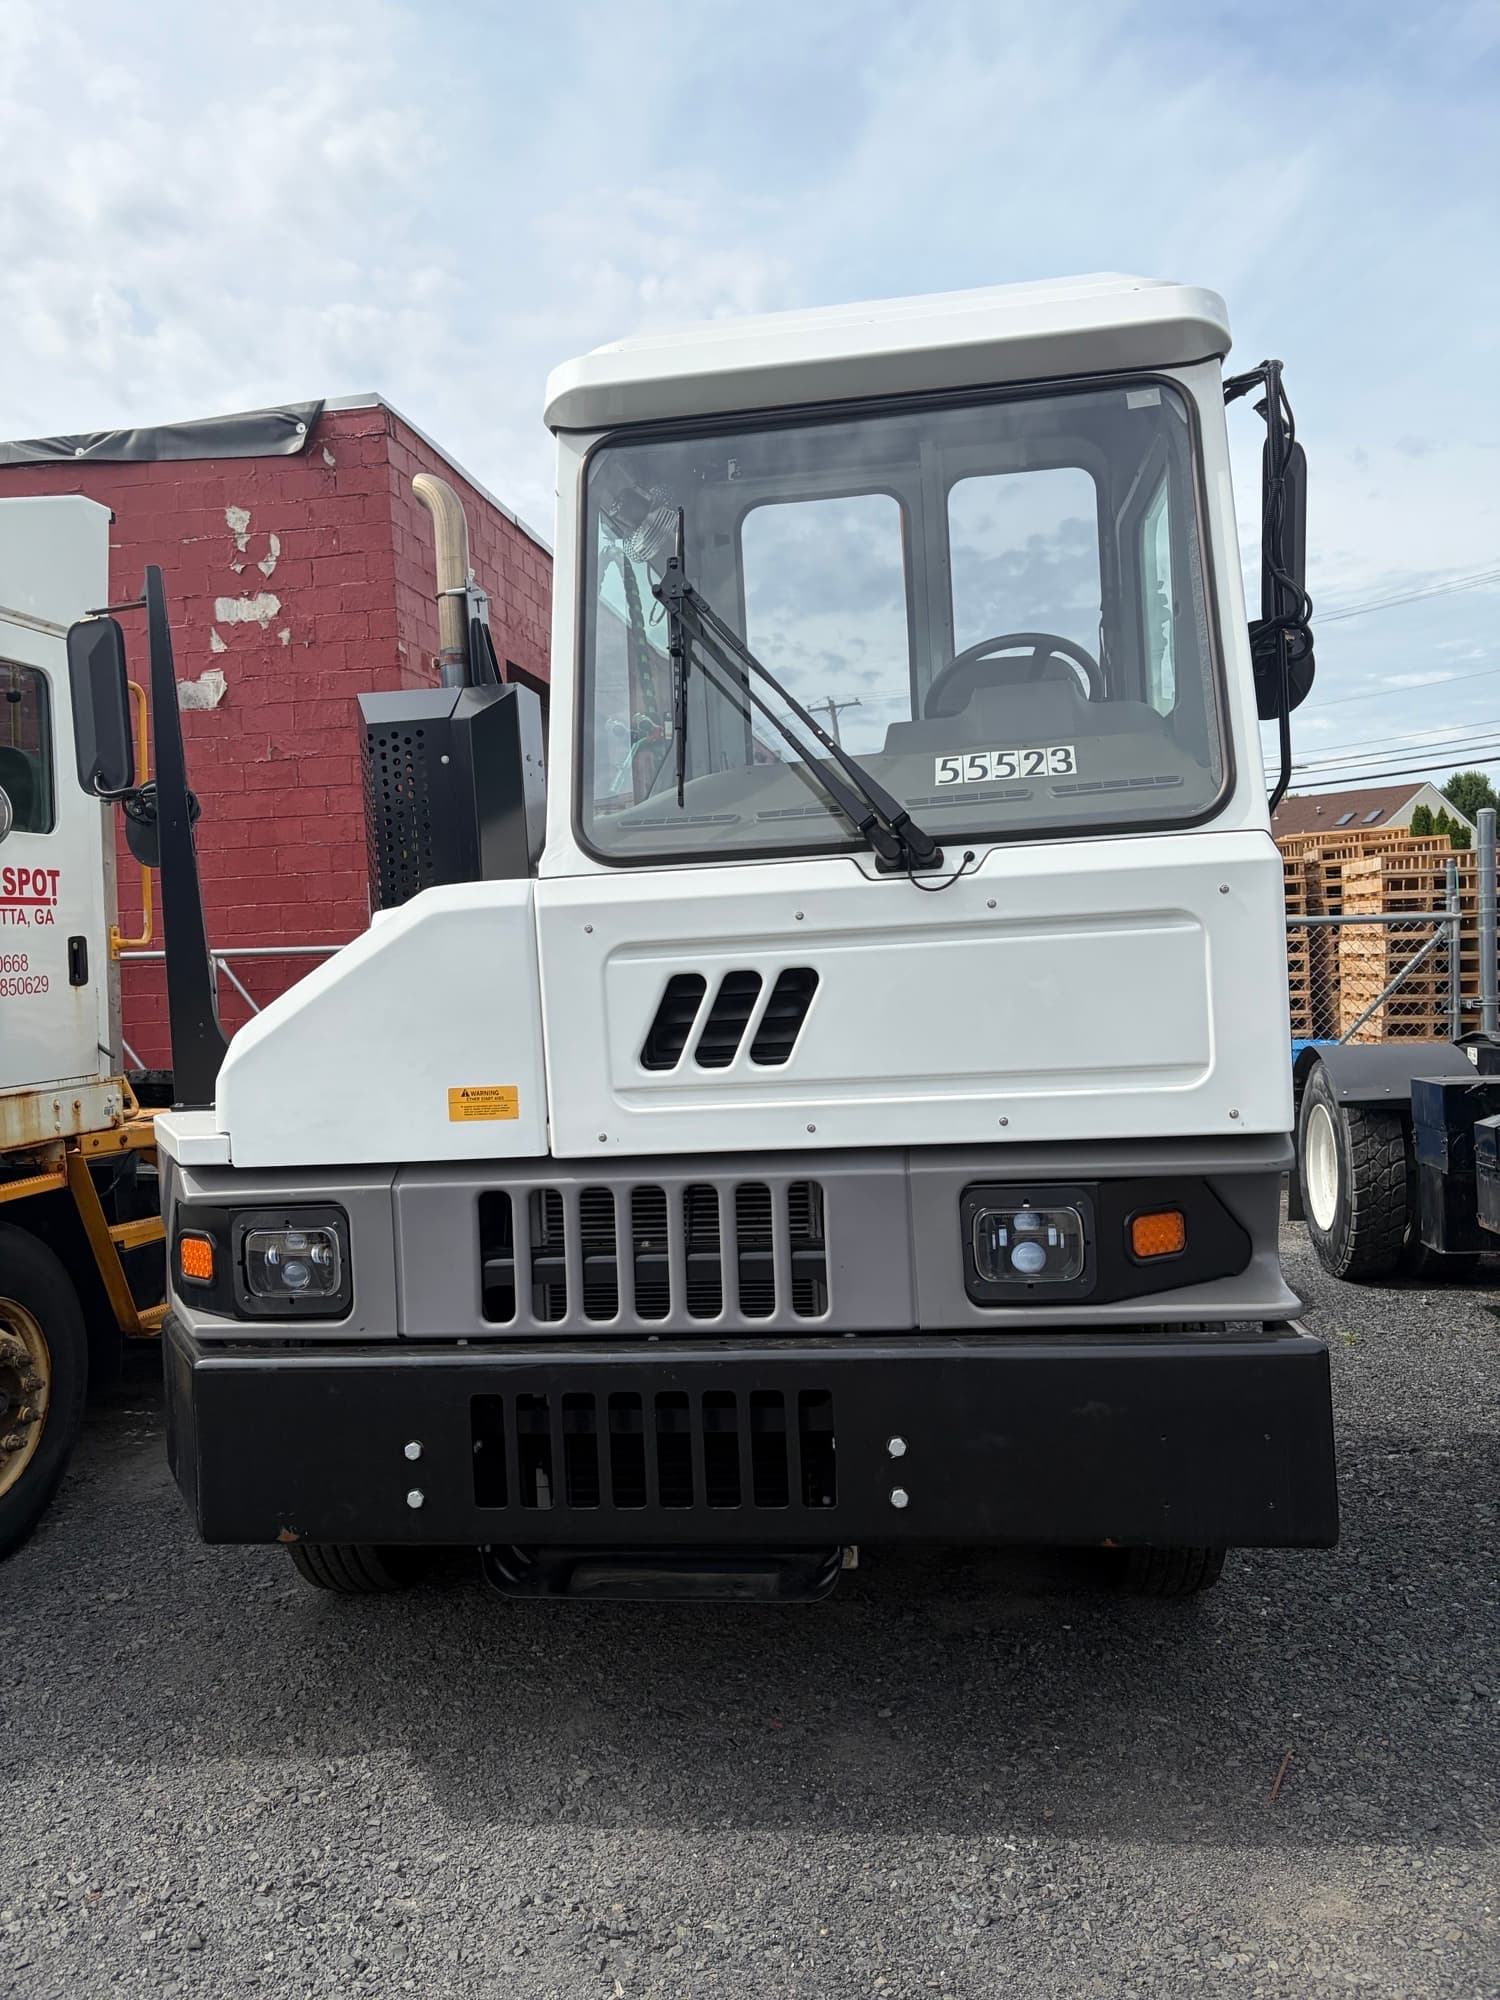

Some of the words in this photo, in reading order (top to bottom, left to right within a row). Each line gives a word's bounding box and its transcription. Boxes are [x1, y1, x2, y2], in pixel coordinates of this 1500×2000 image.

[938, 748, 1073, 784] 55523
[2, 867, 60, 897] SPOT
[34, 908, 55, 925] GA
